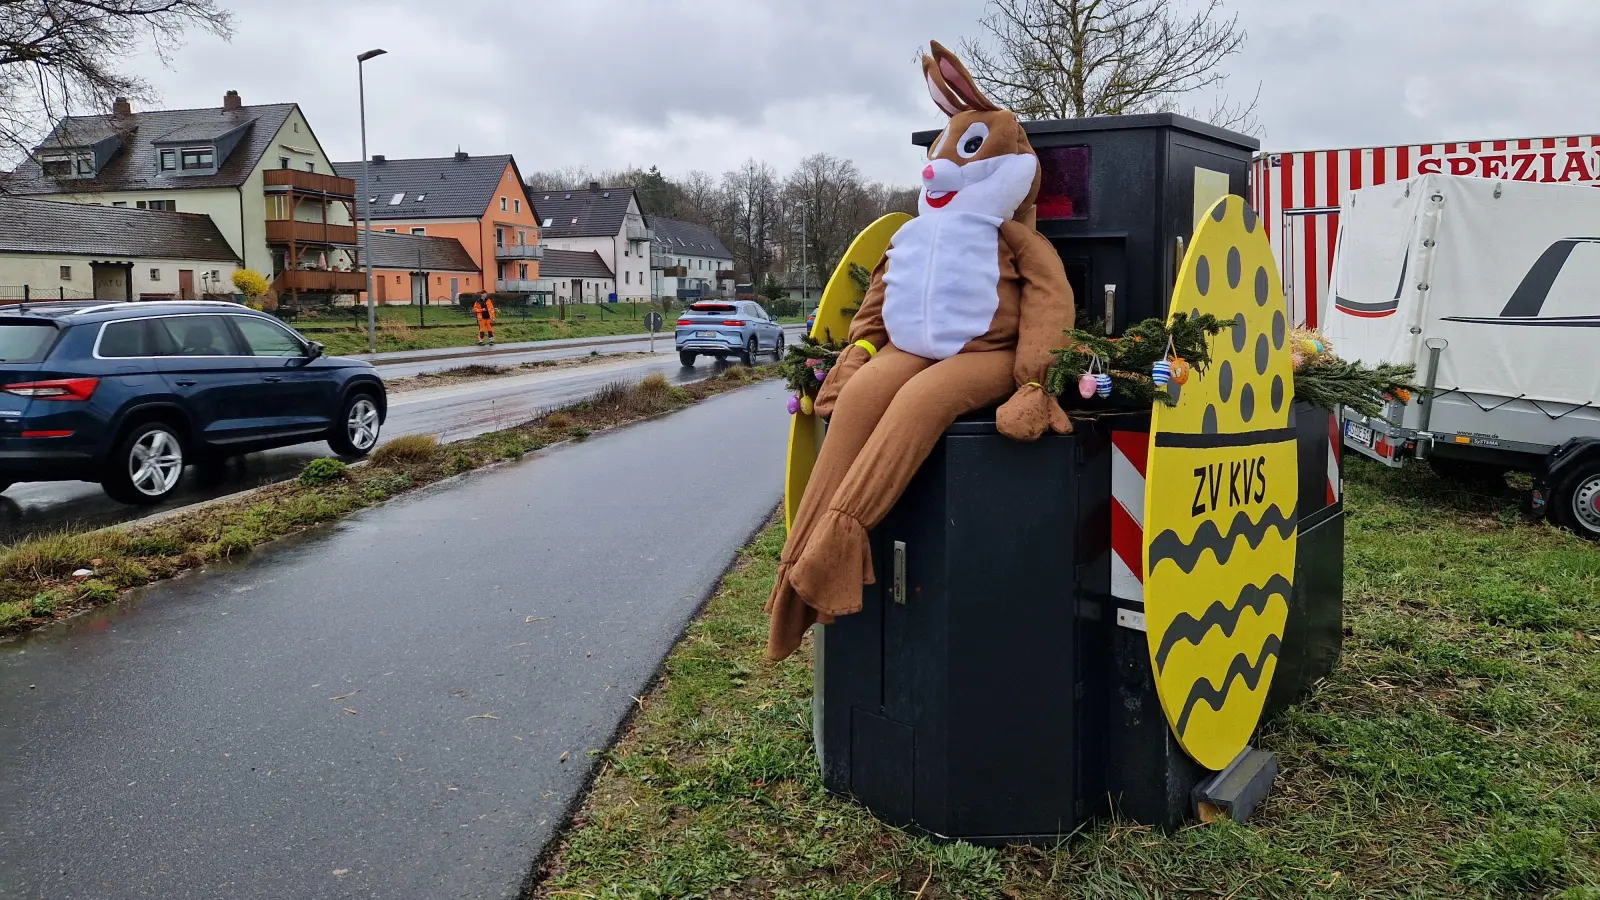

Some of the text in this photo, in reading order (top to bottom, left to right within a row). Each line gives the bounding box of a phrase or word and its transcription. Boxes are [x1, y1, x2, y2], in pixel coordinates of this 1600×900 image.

[1417, 150, 1600, 183] SPEZIA
[1191, 456, 1265, 517] ZV KVS
